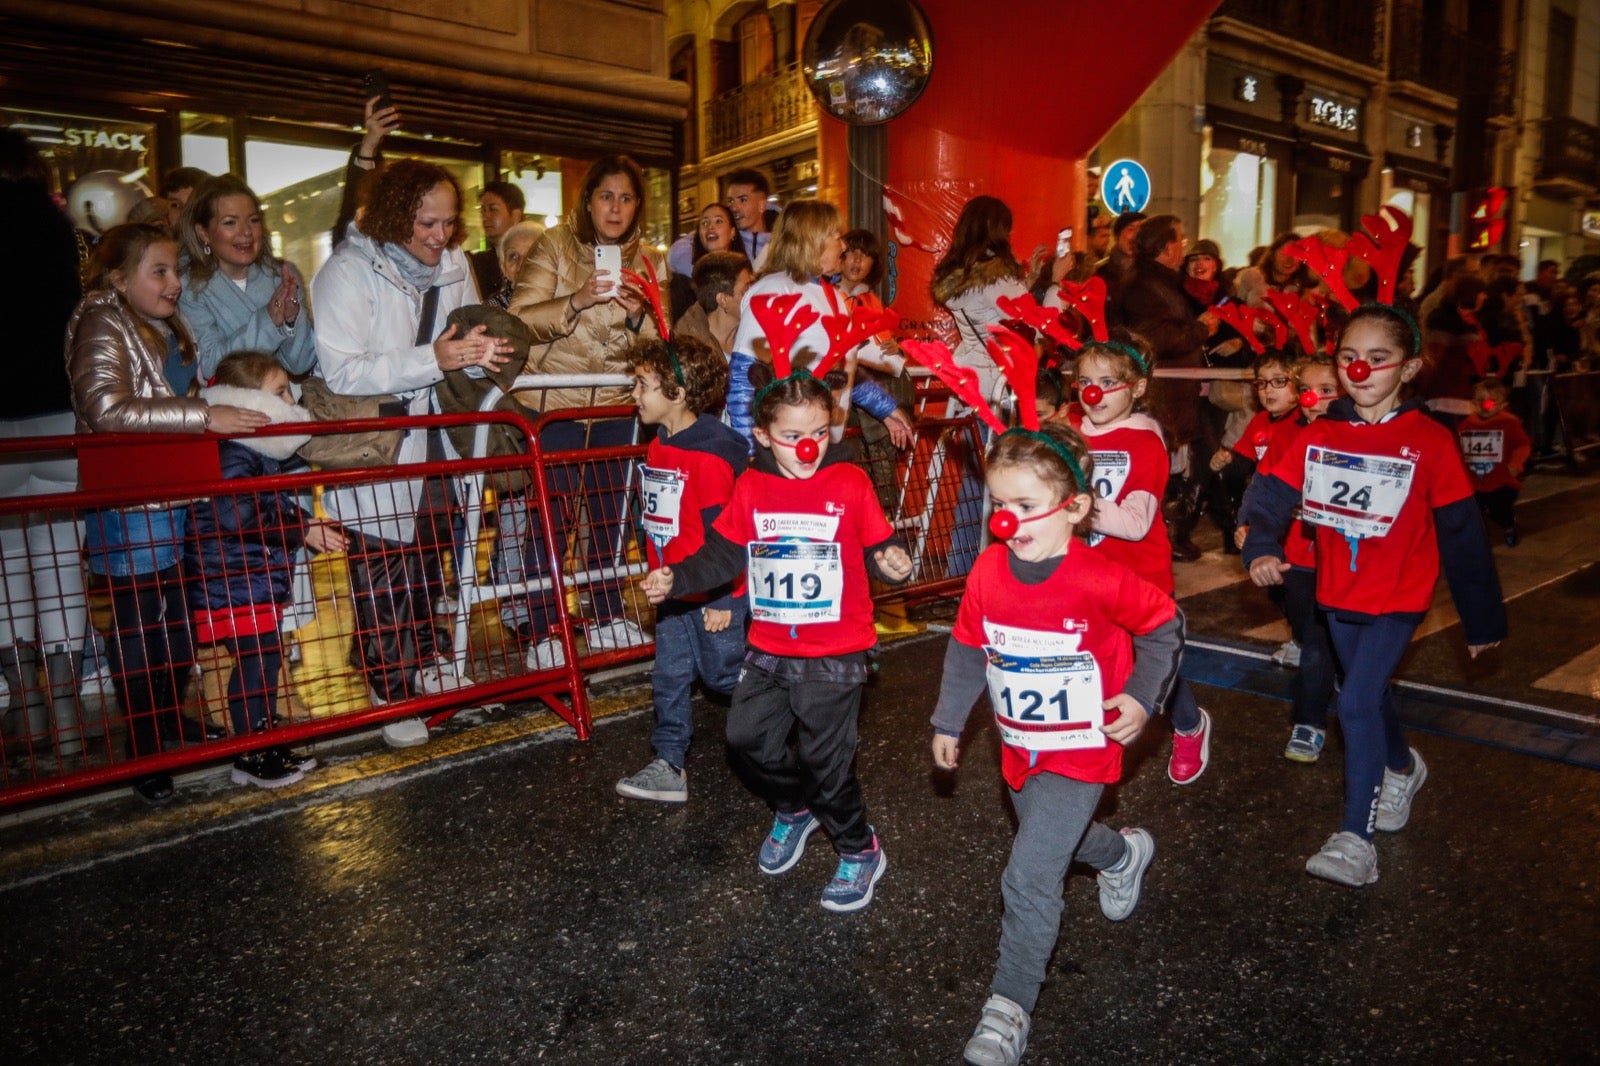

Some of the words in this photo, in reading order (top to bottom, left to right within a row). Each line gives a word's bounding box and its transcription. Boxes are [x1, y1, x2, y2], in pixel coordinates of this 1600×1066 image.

[64, 128, 147, 152] STACK
[1329, 480, 1372, 511] 24
[762, 518, 777, 532] 30
[764, 571, 822, 600] 119
[993, 630, 1006, 646] 30
[1001, 686, 1070, 721] 121
